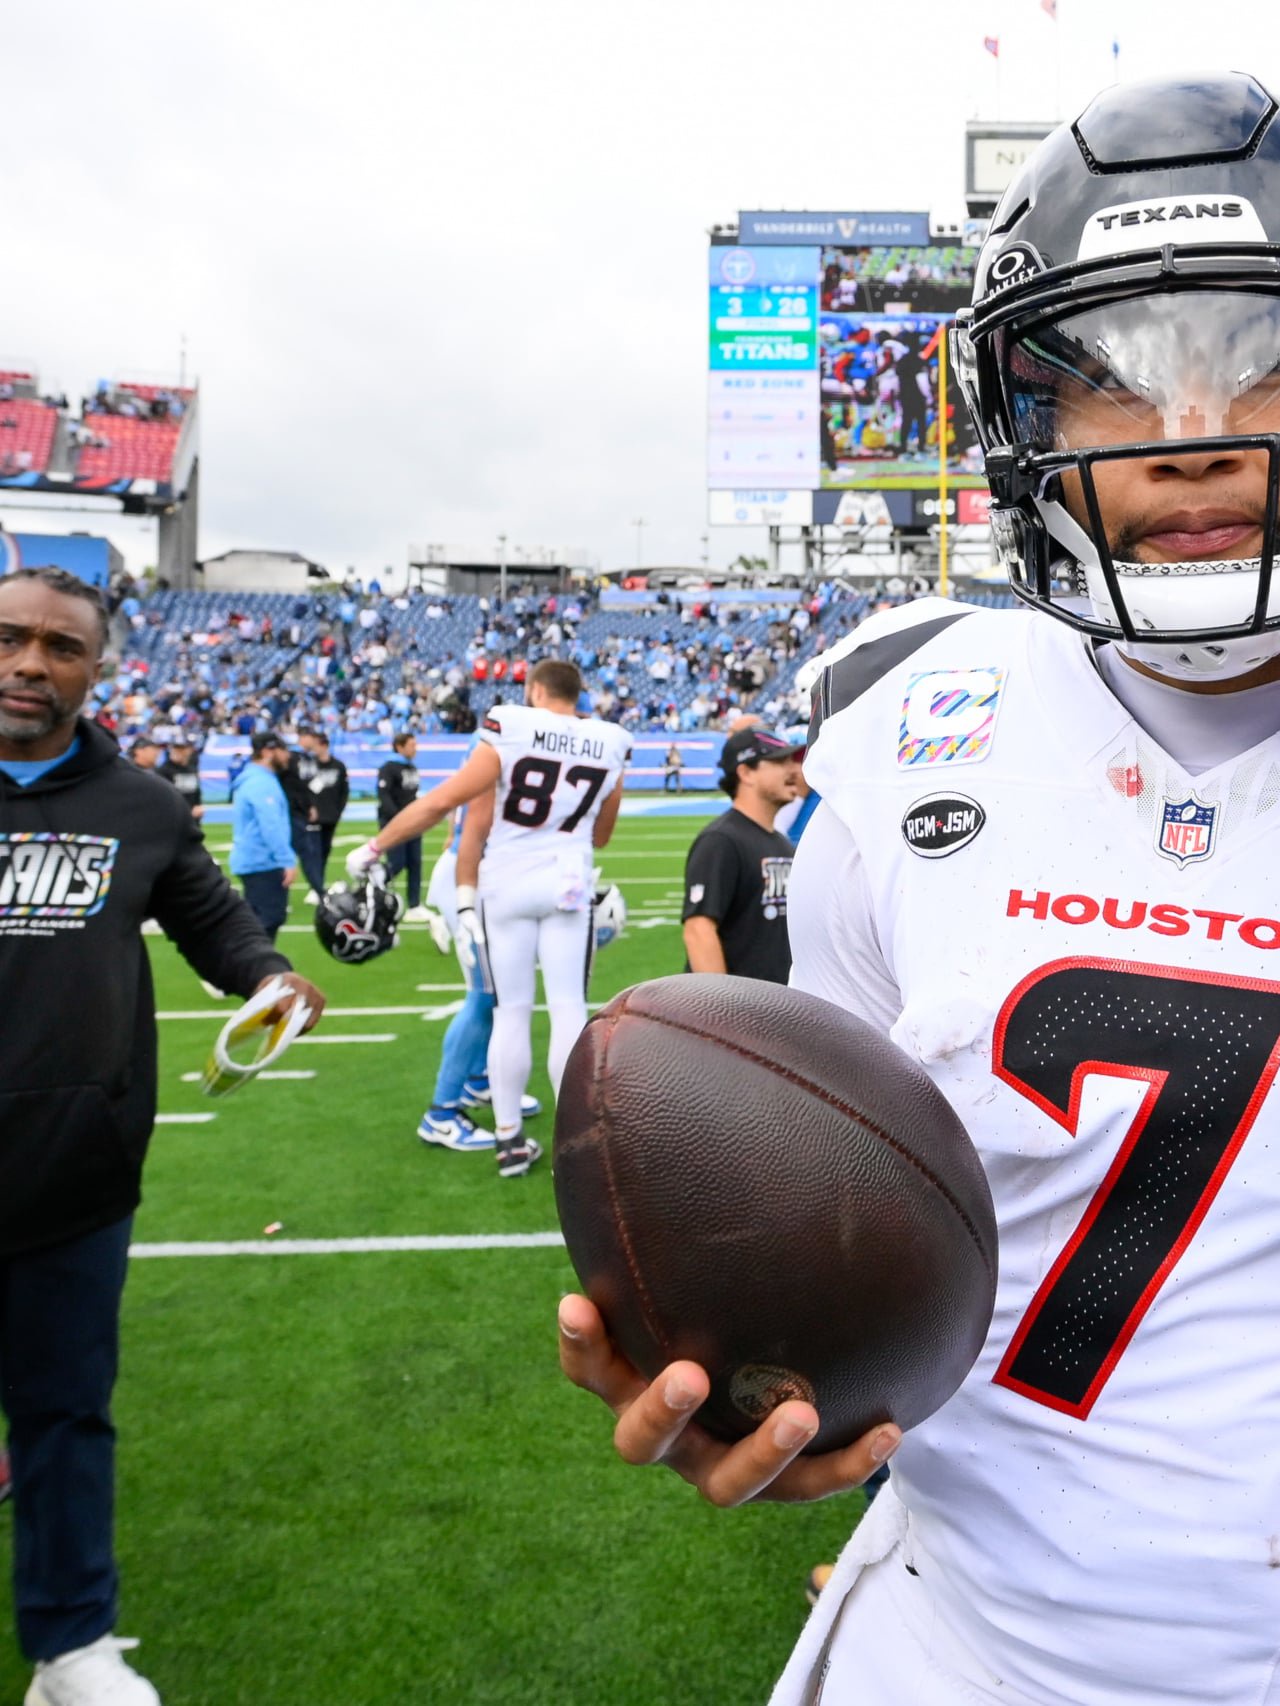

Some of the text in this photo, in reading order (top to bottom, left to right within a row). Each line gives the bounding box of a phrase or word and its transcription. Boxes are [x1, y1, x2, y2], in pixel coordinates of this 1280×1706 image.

[753, 222, 834, 235] VANDERBILT
[859, 223, 912, 236] HEALTH
[1096, 202, 1244, 230] TEXANS
[718, 342, 809, 360] TITANS
[532, 729, 604, 760] MOREAU
[502, 756, 609, 833] 87
[906, 810, 976, 840] RCM JSM
[1164, 823, 1206, 854] NFL
